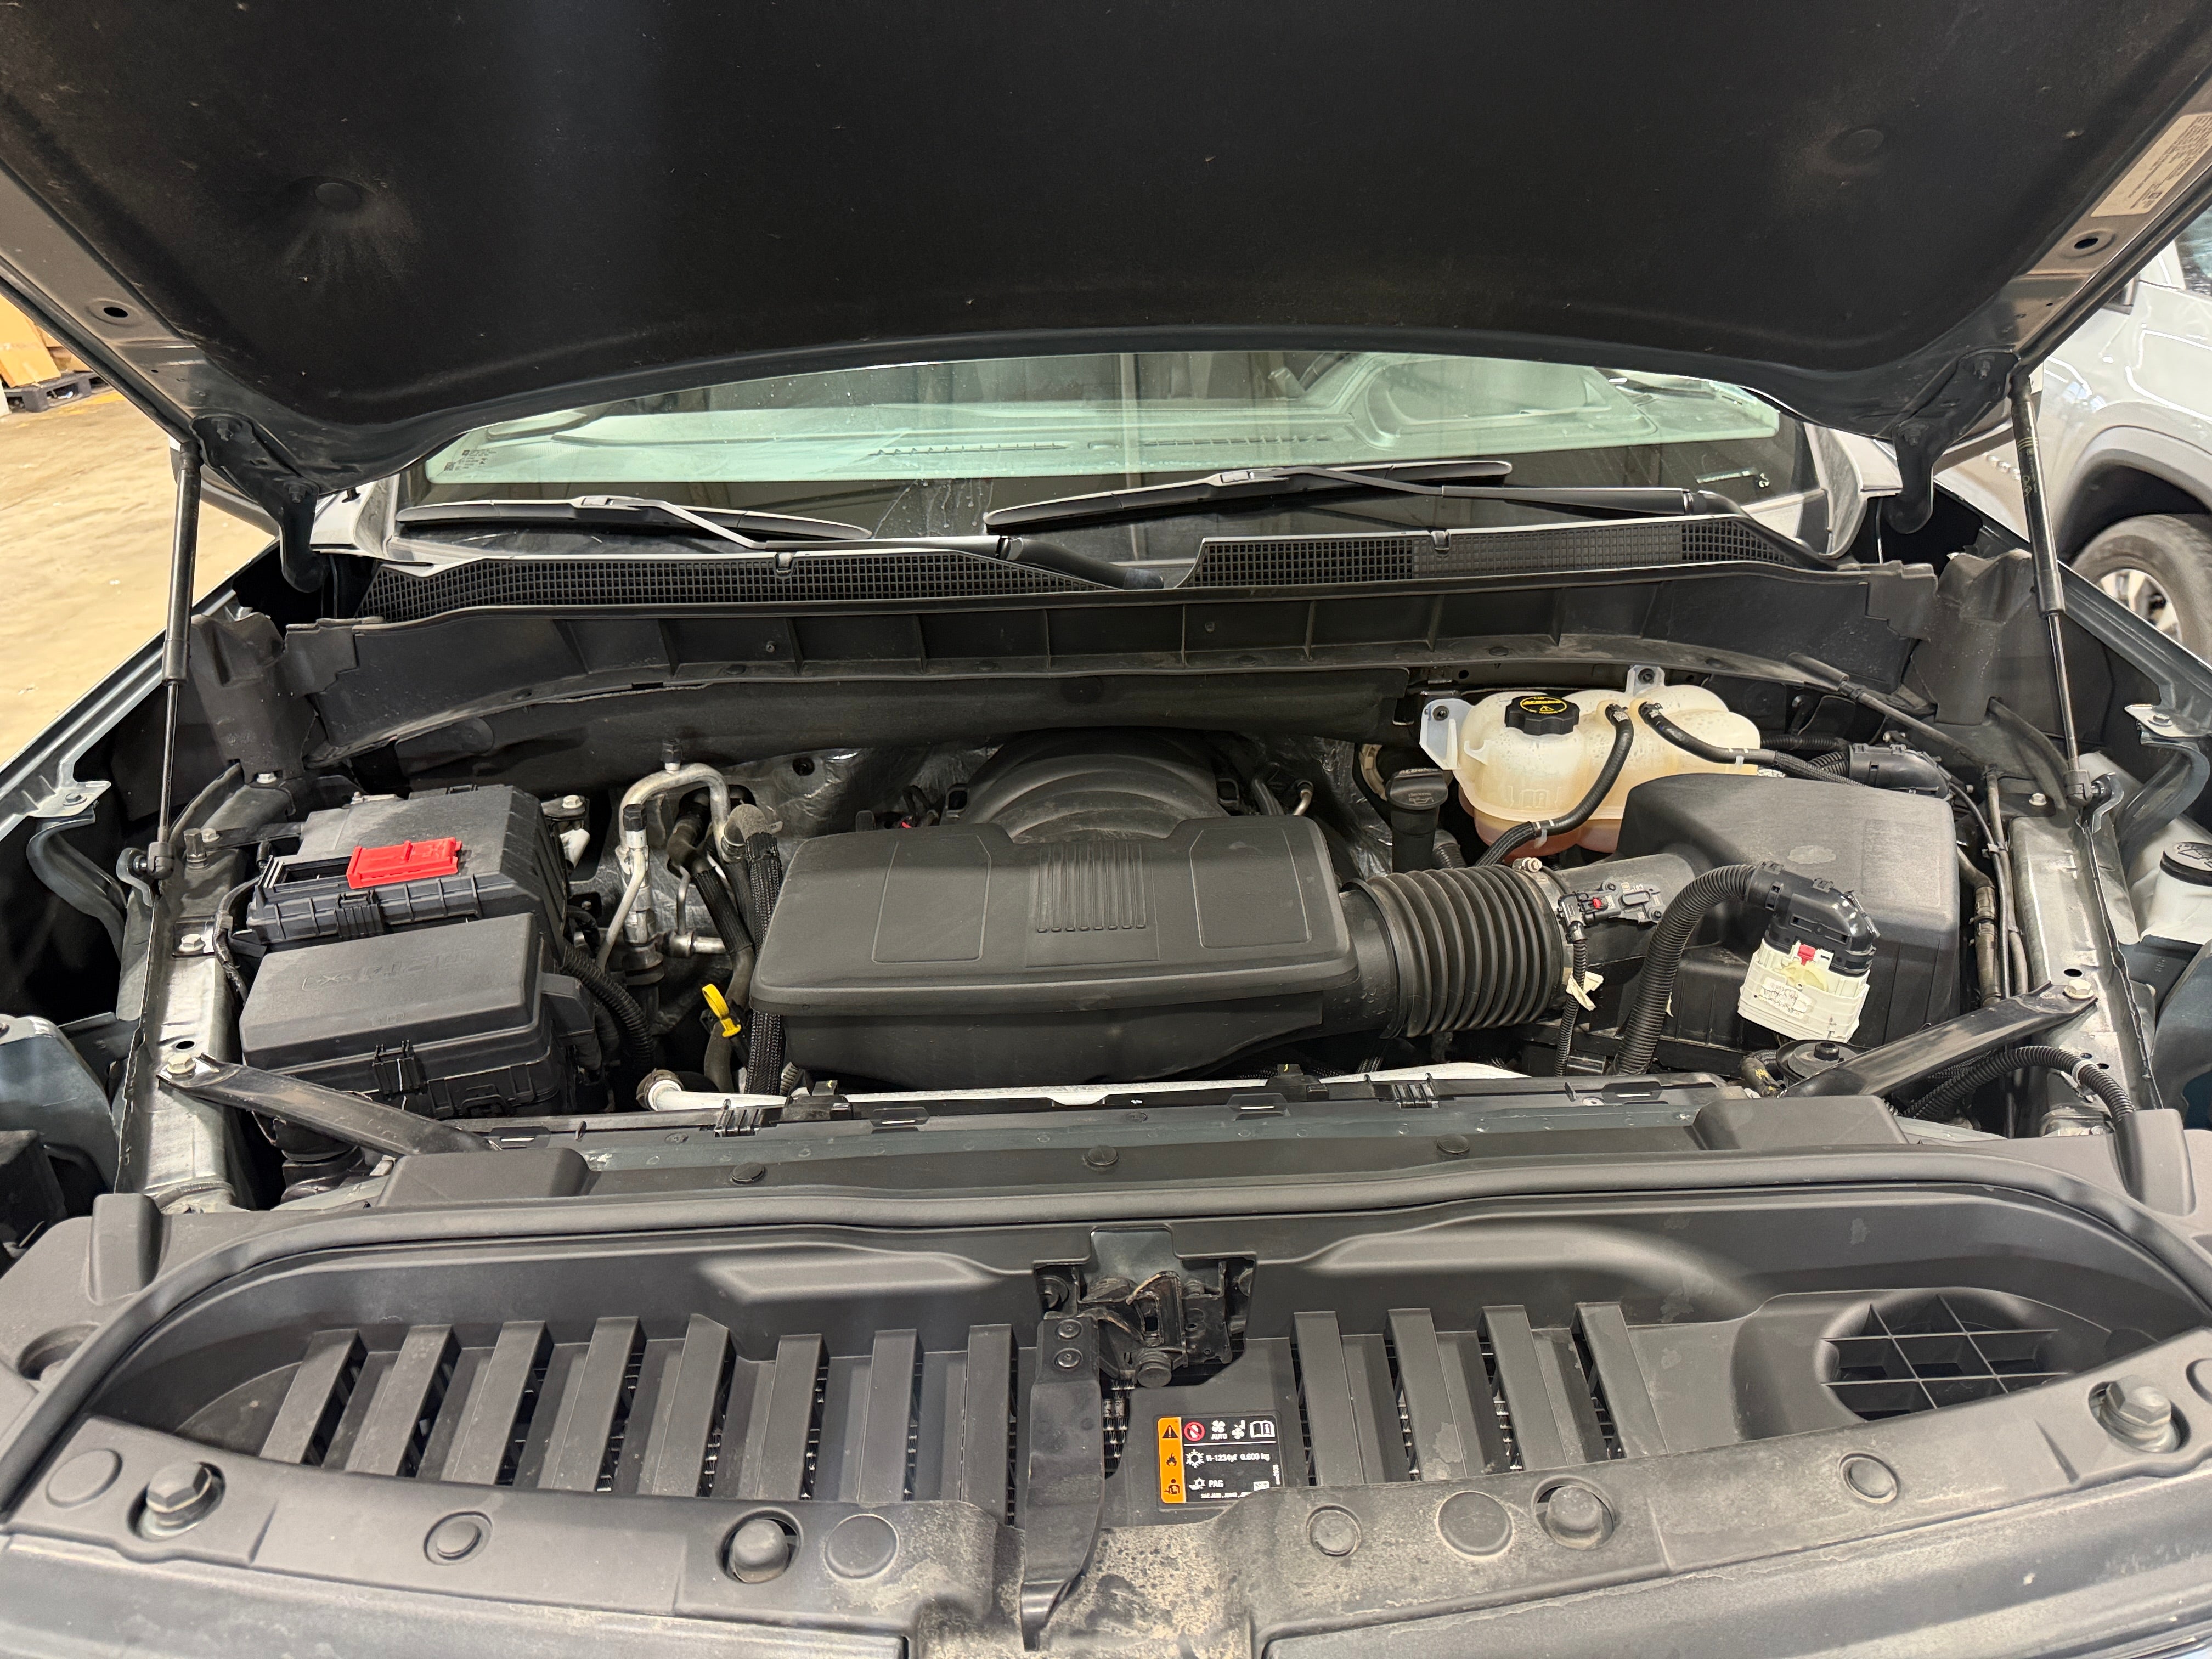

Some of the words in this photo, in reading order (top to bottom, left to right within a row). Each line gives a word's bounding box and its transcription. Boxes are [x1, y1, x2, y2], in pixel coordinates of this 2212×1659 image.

[1206, 1454, 1237, 1462] R-1234yf
[1240, 1453, 1260, 1461] 0.600
[1260, 1452, 1271, 1462] kg
[1208, 1479, 1224, 1488] PAG
